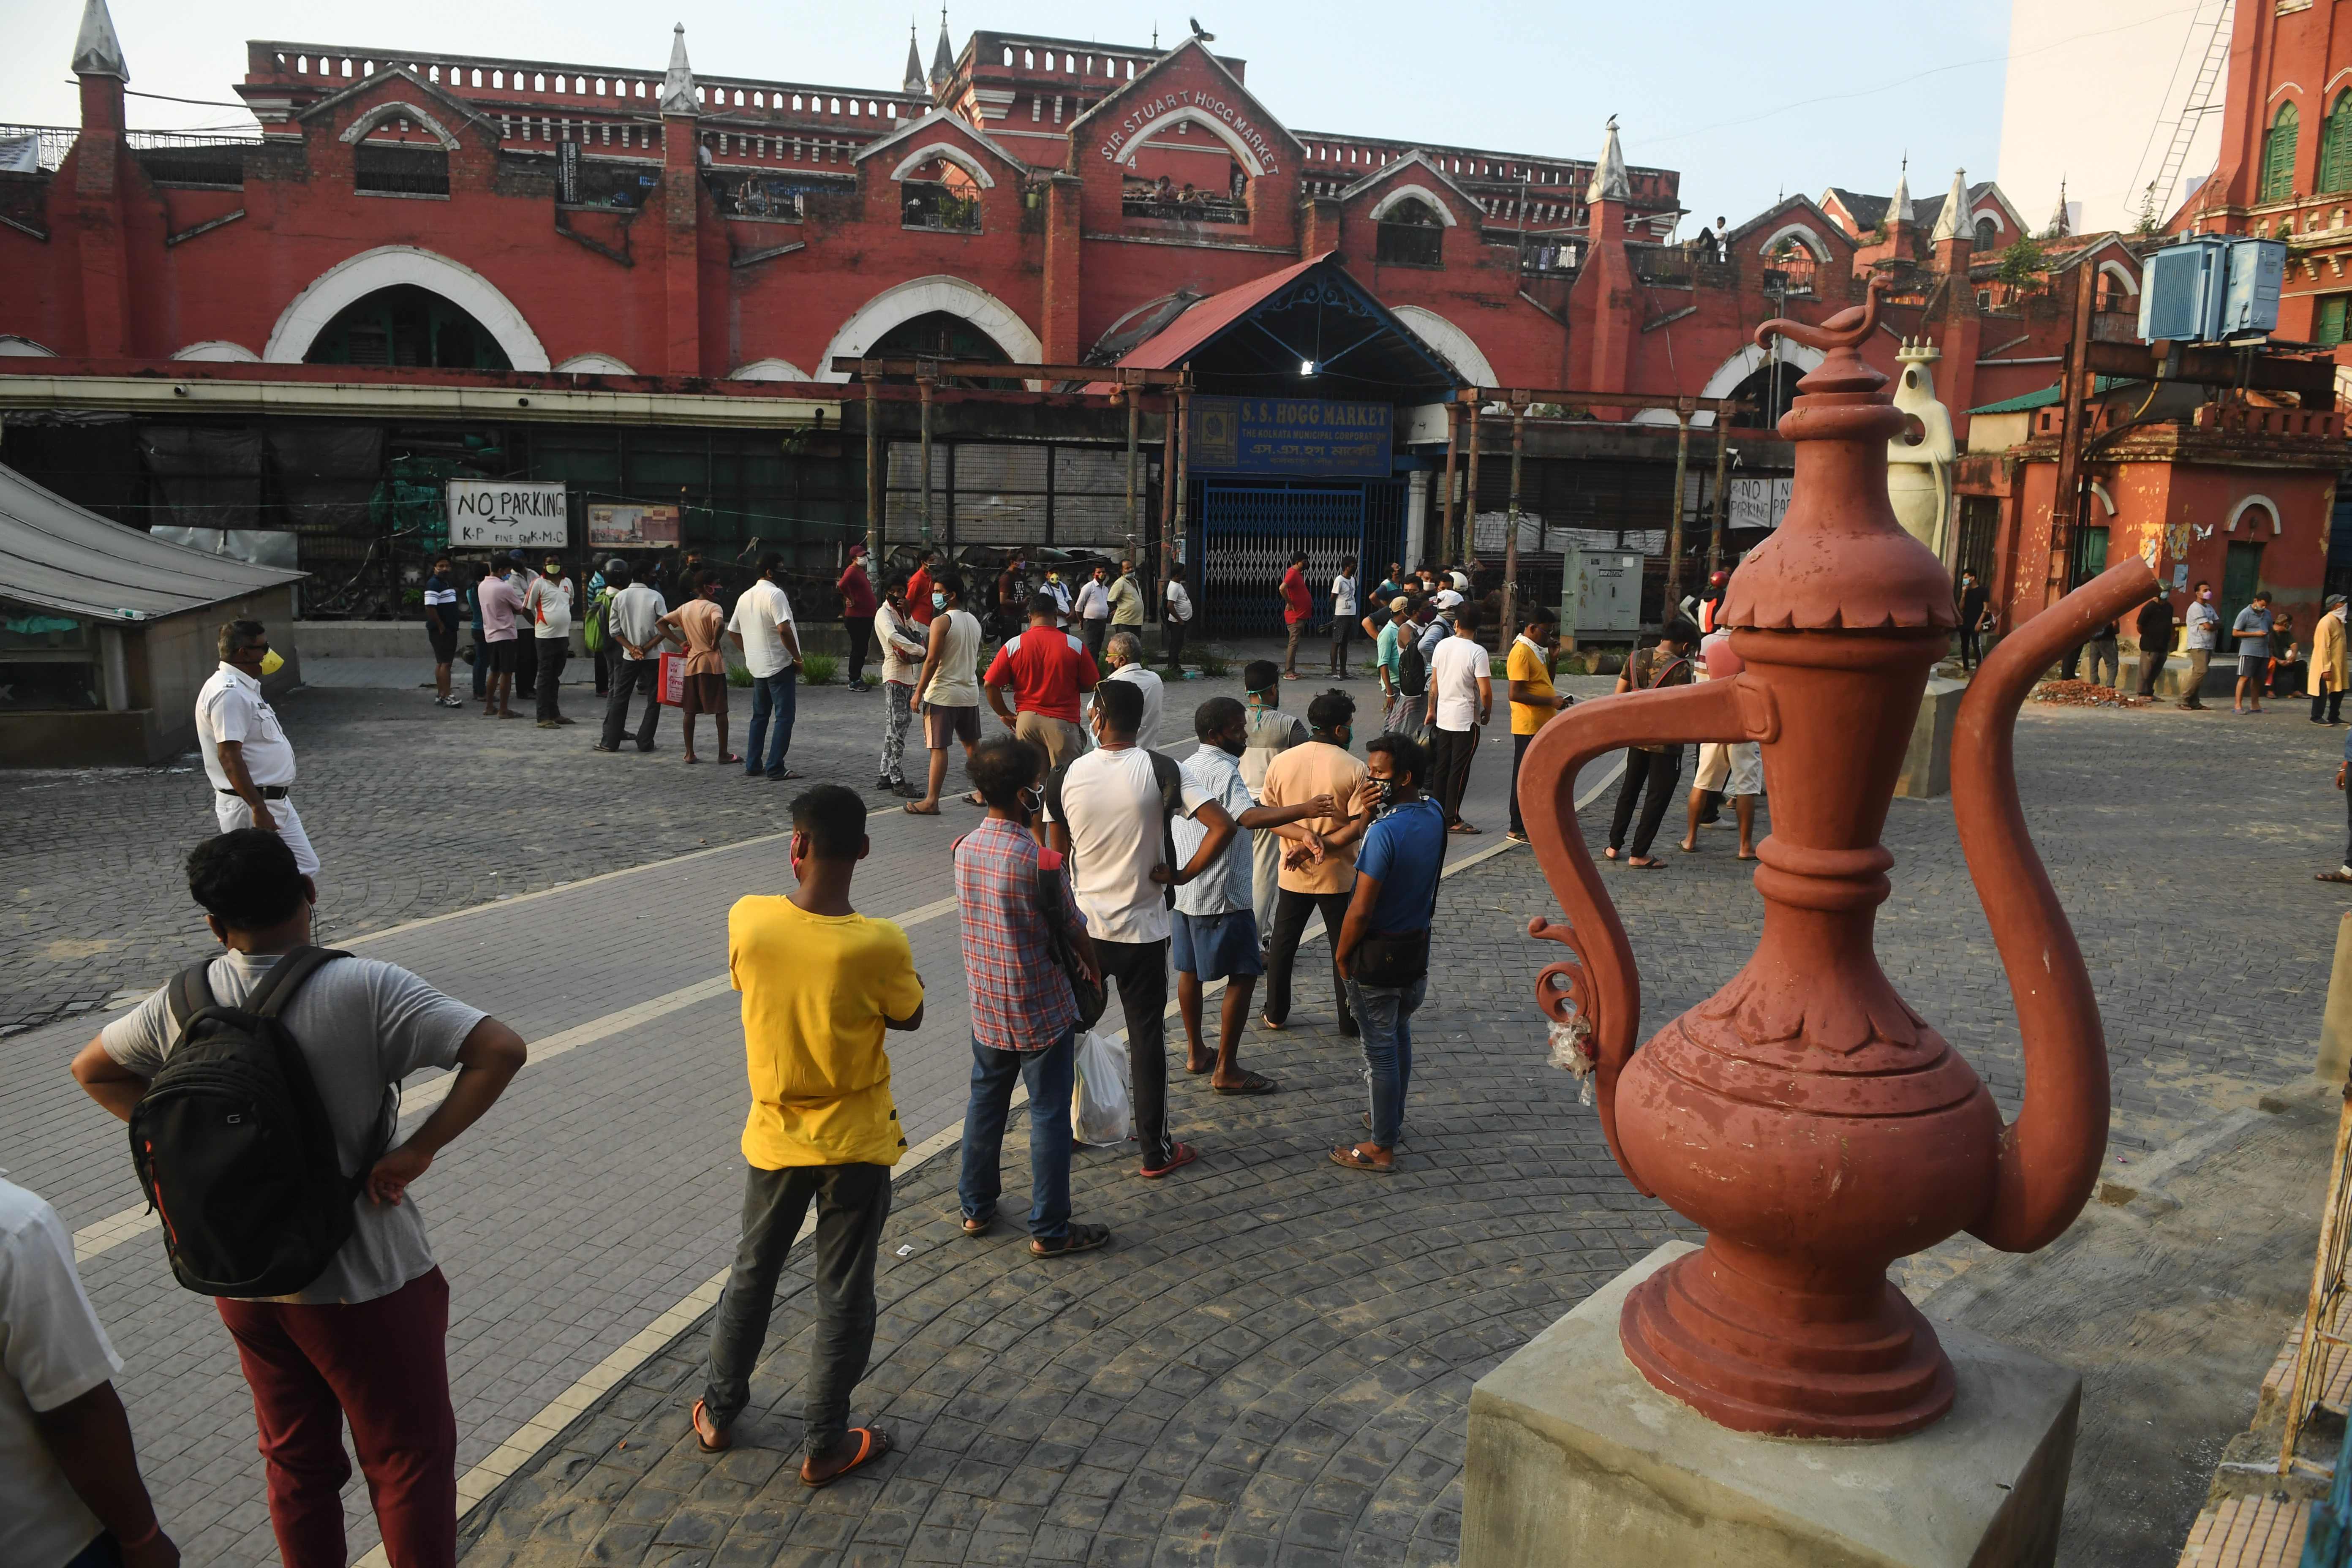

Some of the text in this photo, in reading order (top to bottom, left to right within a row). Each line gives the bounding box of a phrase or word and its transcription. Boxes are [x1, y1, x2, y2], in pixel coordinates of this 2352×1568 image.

[1101, 90, 1279, 177] SIR STUART HOGG MARKET
[1127, 155, 1137, 169] 4
[1242, 402, 1387, 426] S. S. HOGG MARKET
[1242, 429, 1386, 441] THE KOLKATA MUNICIPAL CORPORATION
[1742, 480, 1761, 500] NO
[457, 491, 565, 517] NO PARKING
[1730, 501, 1768, 518] PARKING
[495, 534, 513, 543] FINE
